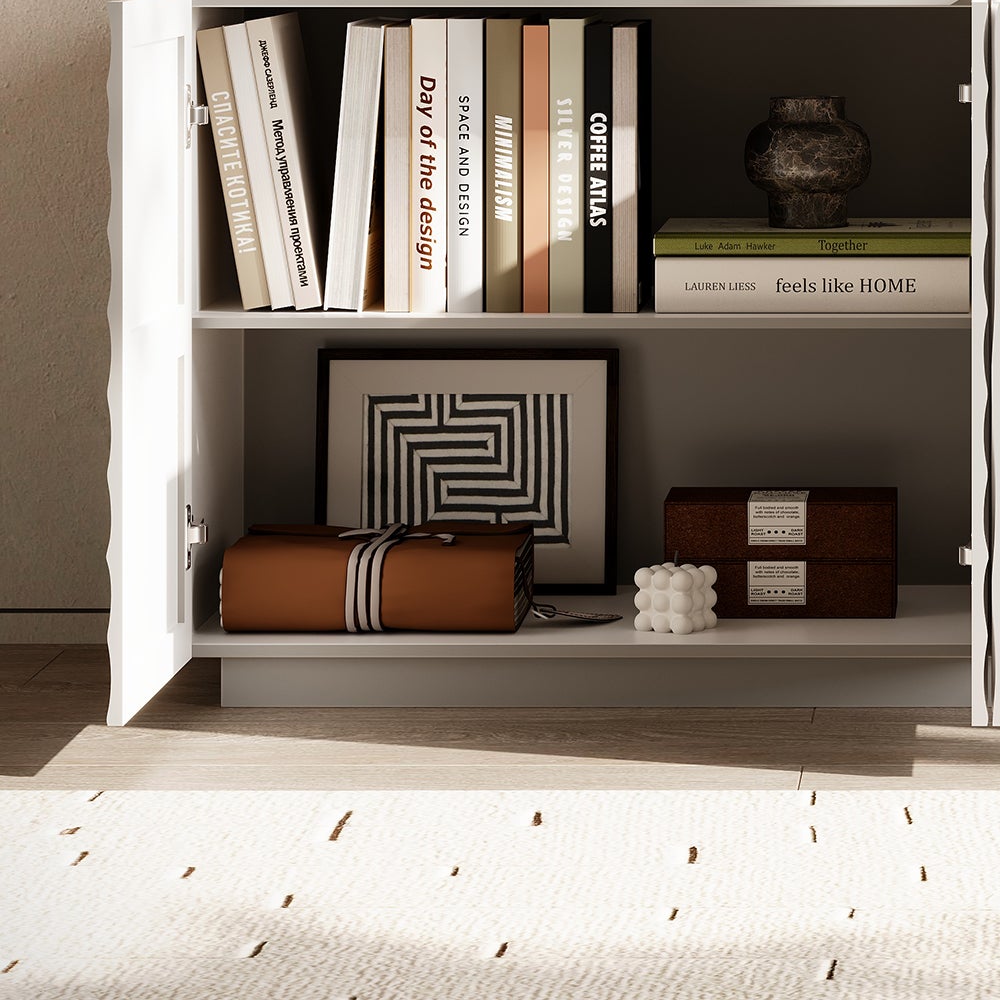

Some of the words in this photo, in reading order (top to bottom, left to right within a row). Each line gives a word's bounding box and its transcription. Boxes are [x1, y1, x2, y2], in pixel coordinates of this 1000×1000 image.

[416, 76, 436, 118] Day
[458, 96, 470, 140] SPACE
[211, 91, 242, 172] СПАСИТЕ
[420, 125, 436, 149] of
[557, 98, 572, 163] SILVER
[590, 112, 608, 172] COFFEE
[420, 154, 436, 190] the
[458, 146, 470, 176] AND
[494, 114, 512, 222] MINIMALISM
[226, 173, 257, 254] КОТИКА!
[272, 119, 286, 156] Метод
[290, 226, 309, 288] проектами
[458, 184, 470, 236] DESIGN
[557, 174, 572, 241] DESIGN
[590, 176, 607, 227] ATLAS
[416, 198, 436, 270] design
[694, 242, 713, 250] Luke
[718, 242, 741, 250] Adam
[746, 242, 776, 250] Hawker
[818, 239, 868, 253] Together
[685, 282, 726, 292] LAUREN
[728, 282, 756, 292] LIESS
[776, 278, 816, 294] feels
[822, 278, 854, 294] like
[859, 278, 916, 294] HOME
